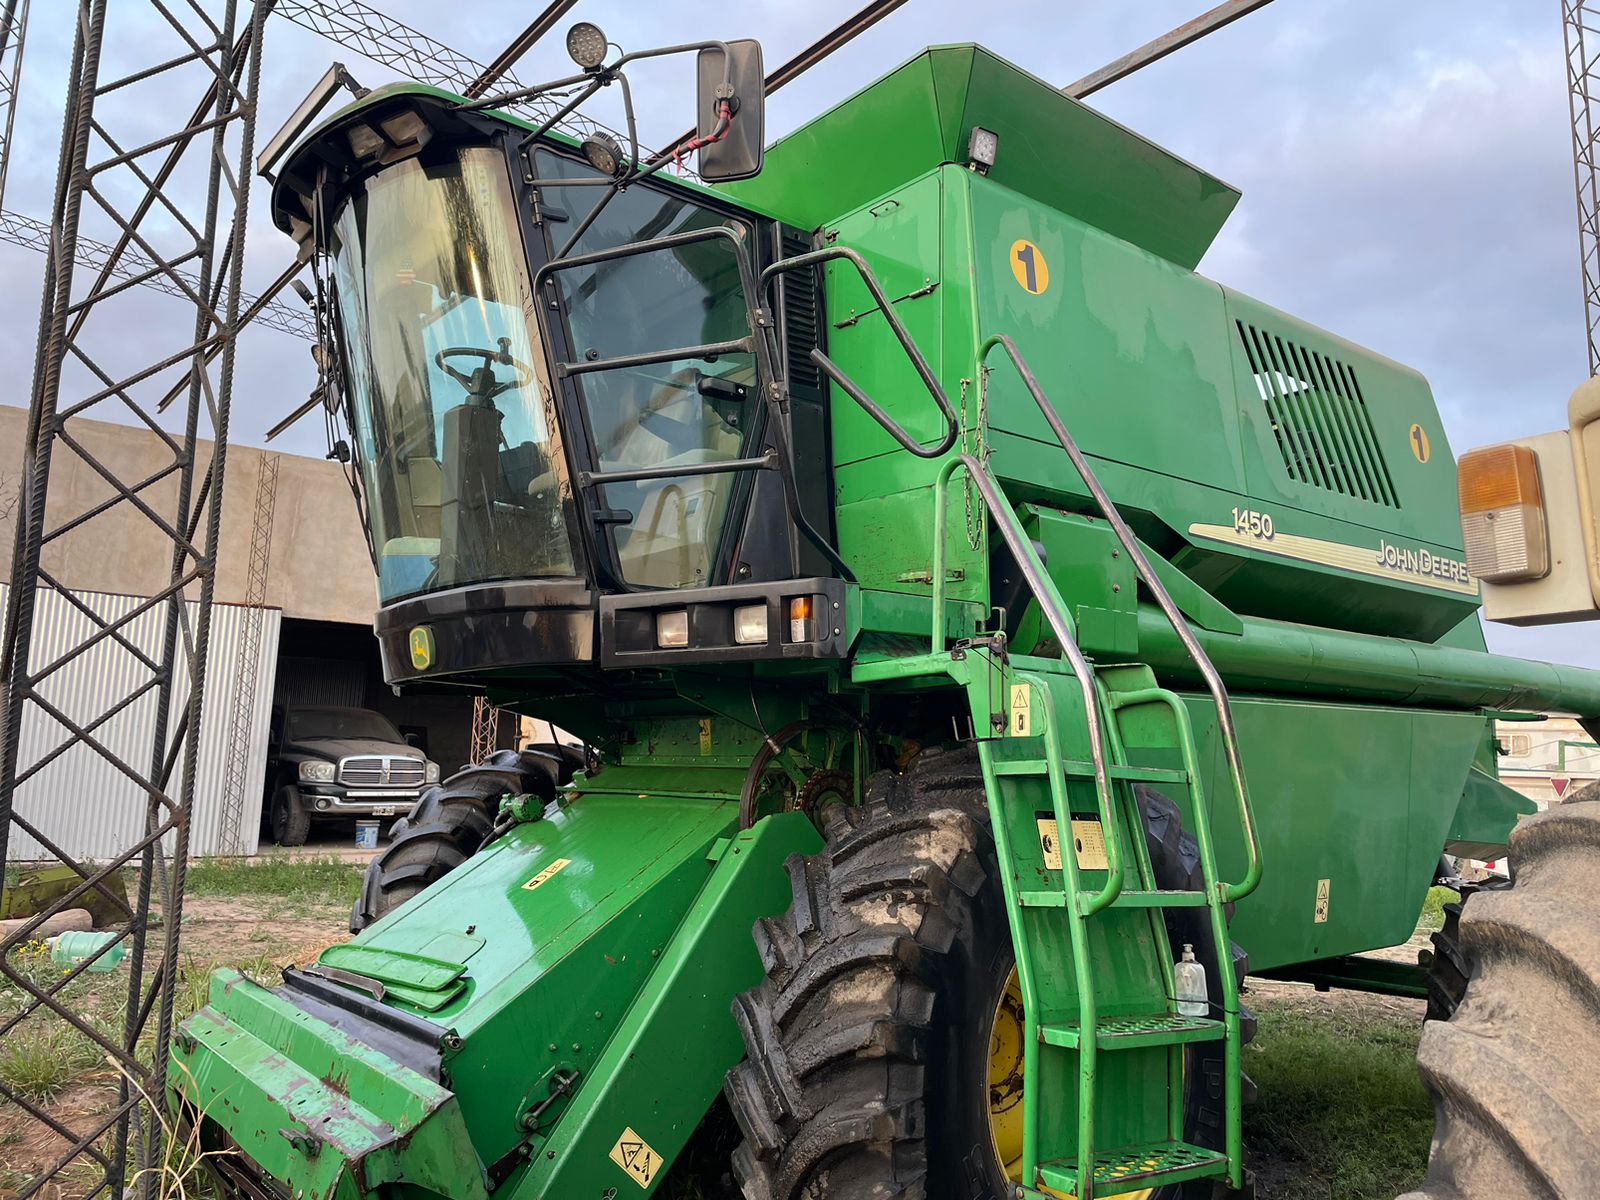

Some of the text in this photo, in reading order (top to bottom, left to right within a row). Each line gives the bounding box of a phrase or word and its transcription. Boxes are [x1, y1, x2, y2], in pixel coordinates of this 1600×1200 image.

[1017, 244, 1037, 292] 1
[1412, 425, 1425, 462] 1
[1231, 507, 1273, 539] 1450
[1376, 539, 1469, 583] JOHN DEERE
